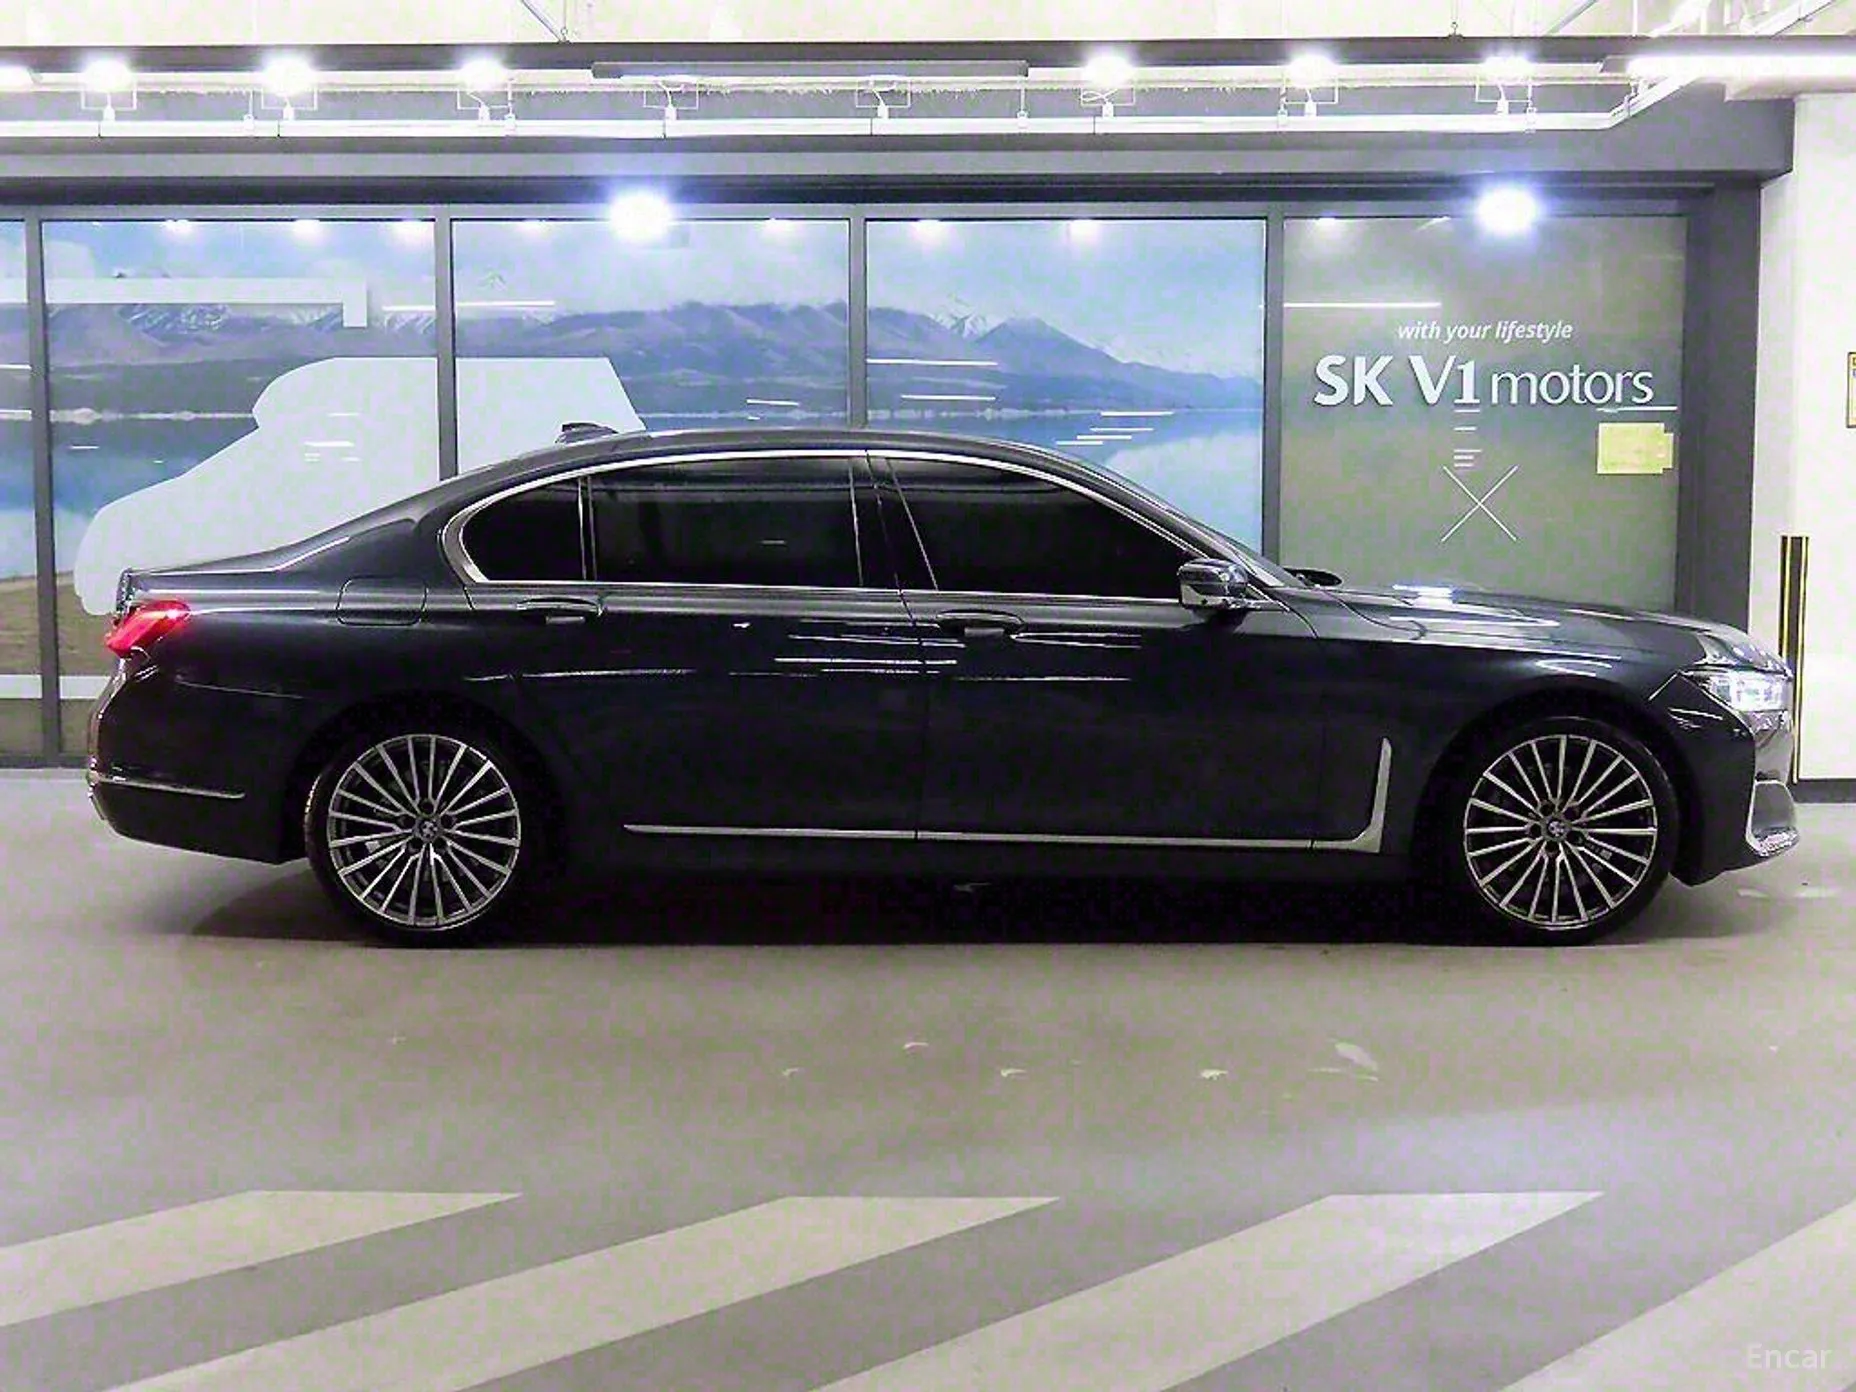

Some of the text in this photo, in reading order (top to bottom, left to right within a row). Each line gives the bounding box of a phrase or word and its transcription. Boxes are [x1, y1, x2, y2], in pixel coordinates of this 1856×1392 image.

[1398, 320, 1573, 344] with your lifestyle
[1314, 354, 1655, 407] SK V1 motors
